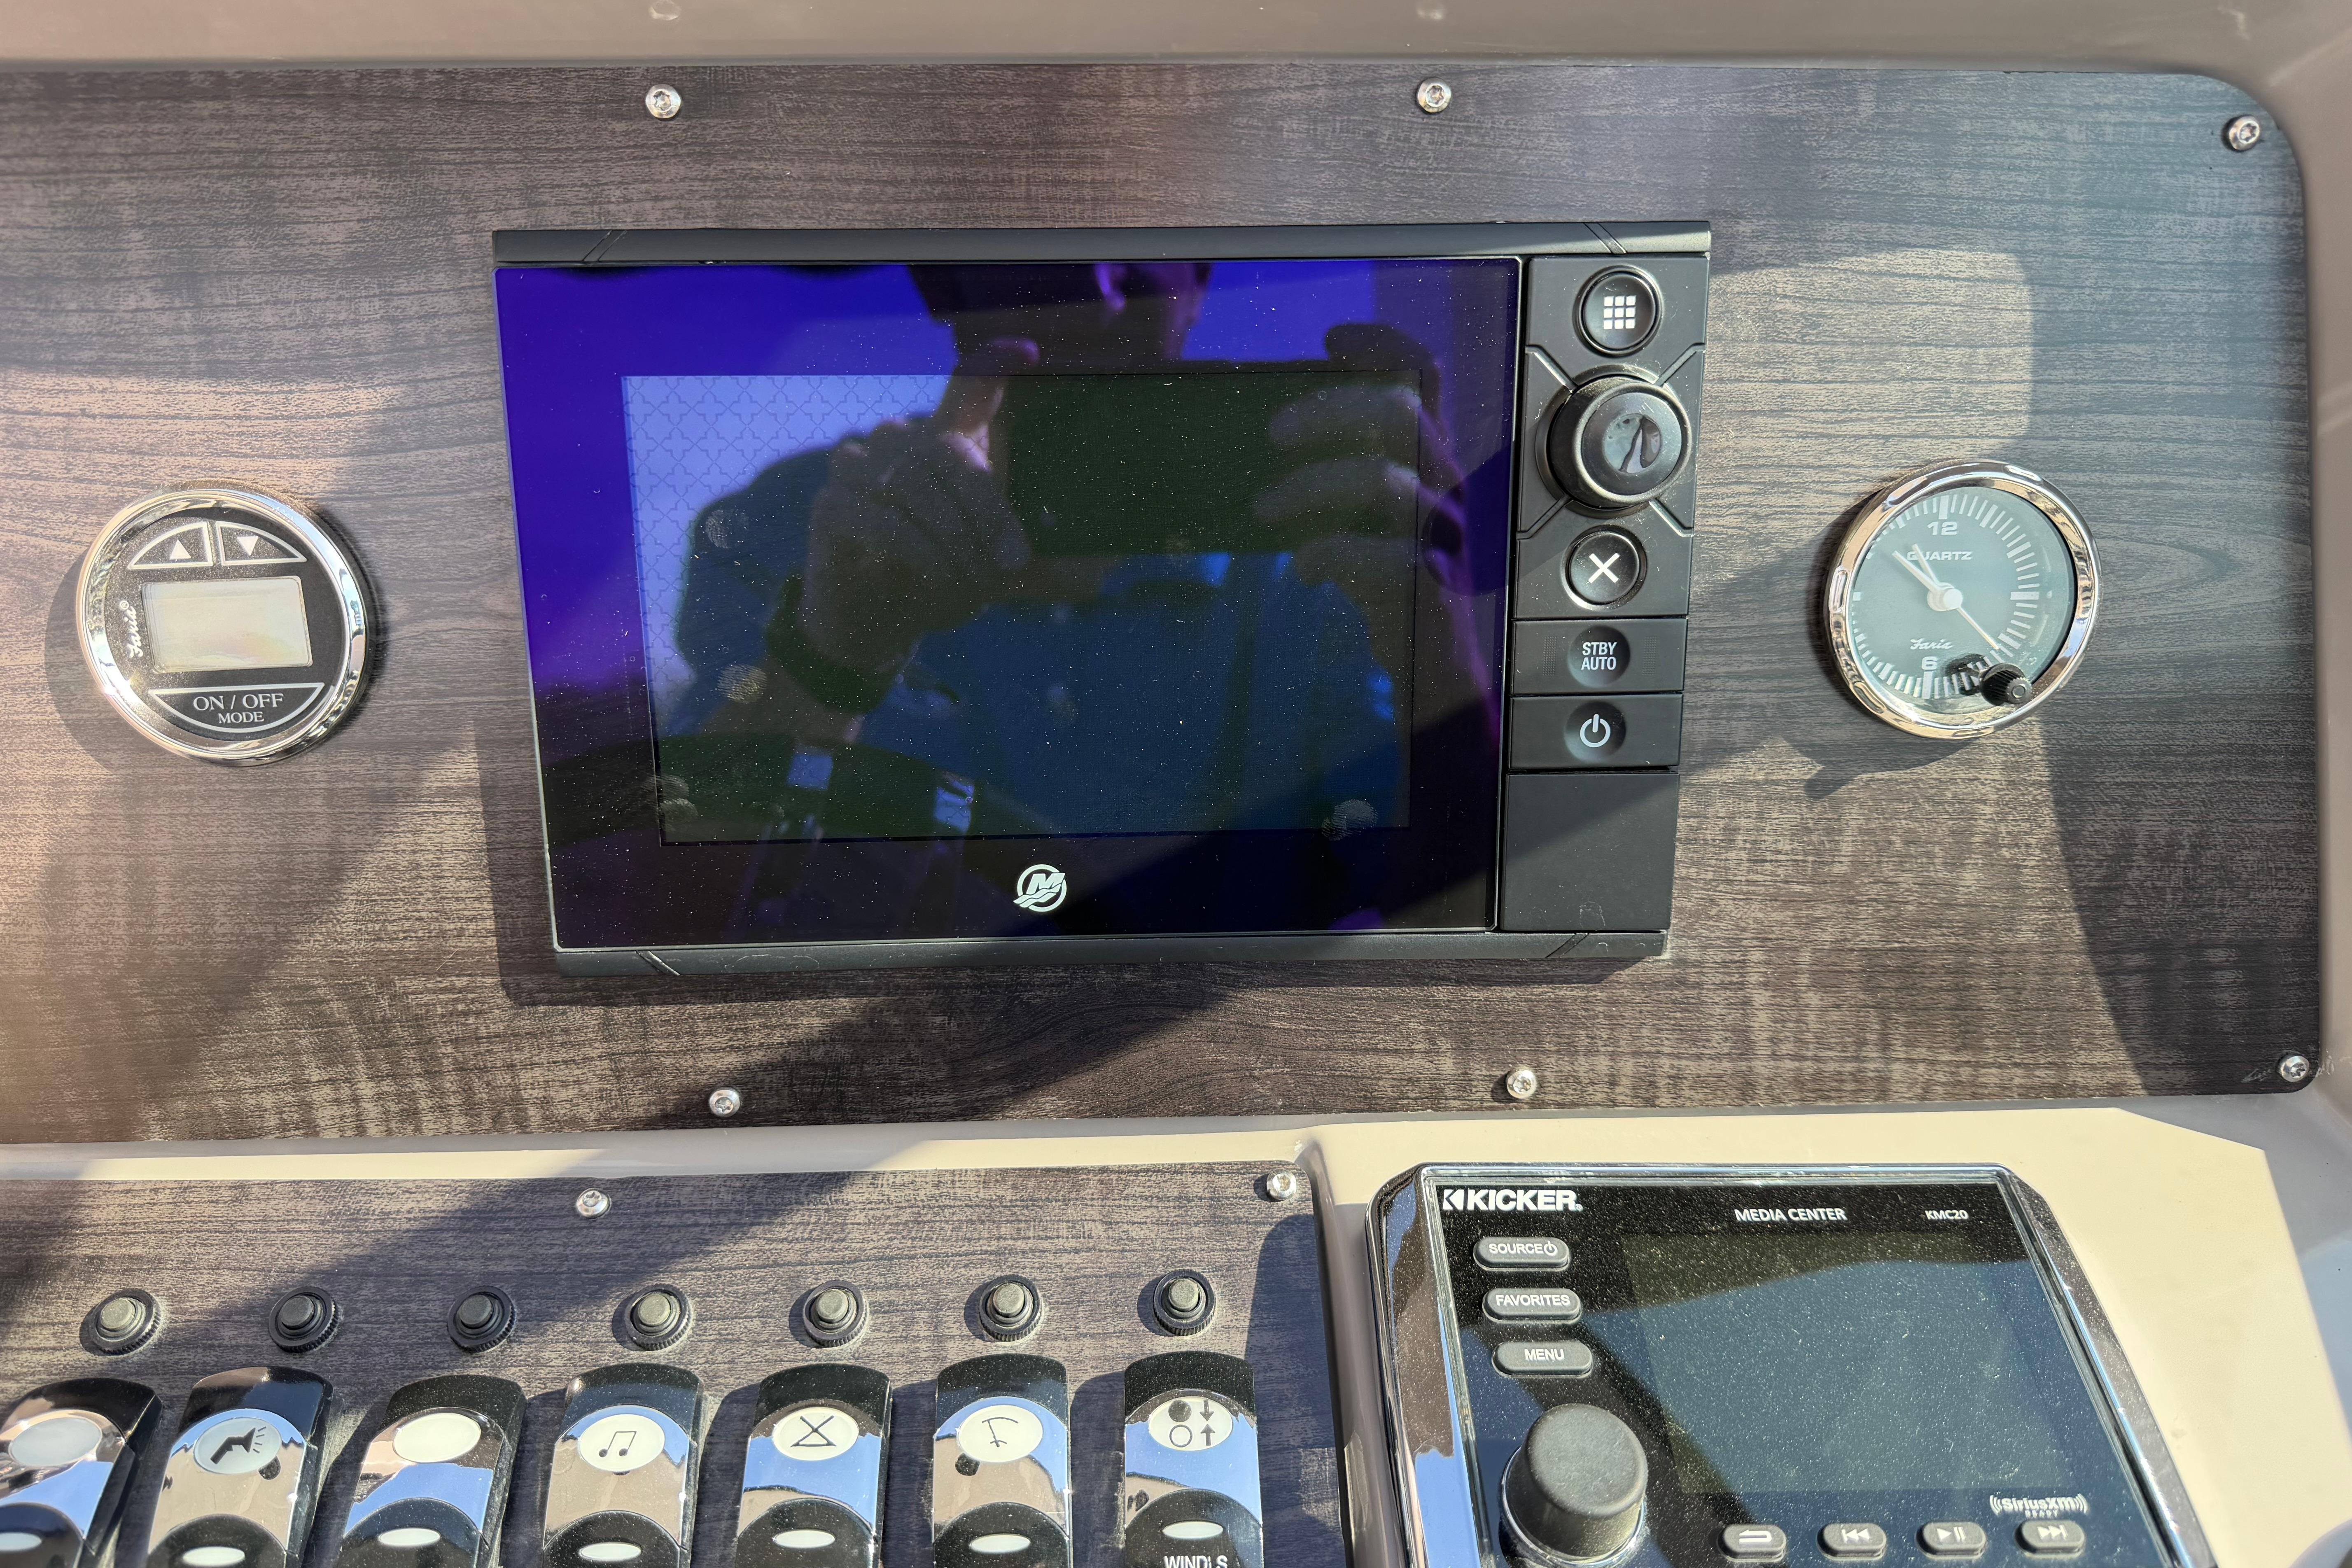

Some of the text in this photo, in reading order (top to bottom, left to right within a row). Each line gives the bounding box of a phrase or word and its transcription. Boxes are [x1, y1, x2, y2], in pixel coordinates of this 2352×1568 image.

[1927, 521, 1958, 536] 12
[1906, 551, 1973, 560] QUARTZ
[1582, 642, 1618, 656] STBY
[1581, 656, 1617, 670] AUTO
[1921, 656, 1938, 670] 6
[193, 696, 224, 711] ON
[242, 693, 284, 709] OFF
[217, 711, 265, 724] MODE
[1734, 1208, 1848, 1222] MEDIA CENTER
[1924, 1209, 1969, 1220] KMC20
[1489, 1243, 1545, 1254] SOURCE
[1495, 1294, 1571, 1307] FAVORITES
[1524, 1348, 1565, 1361] MENU
